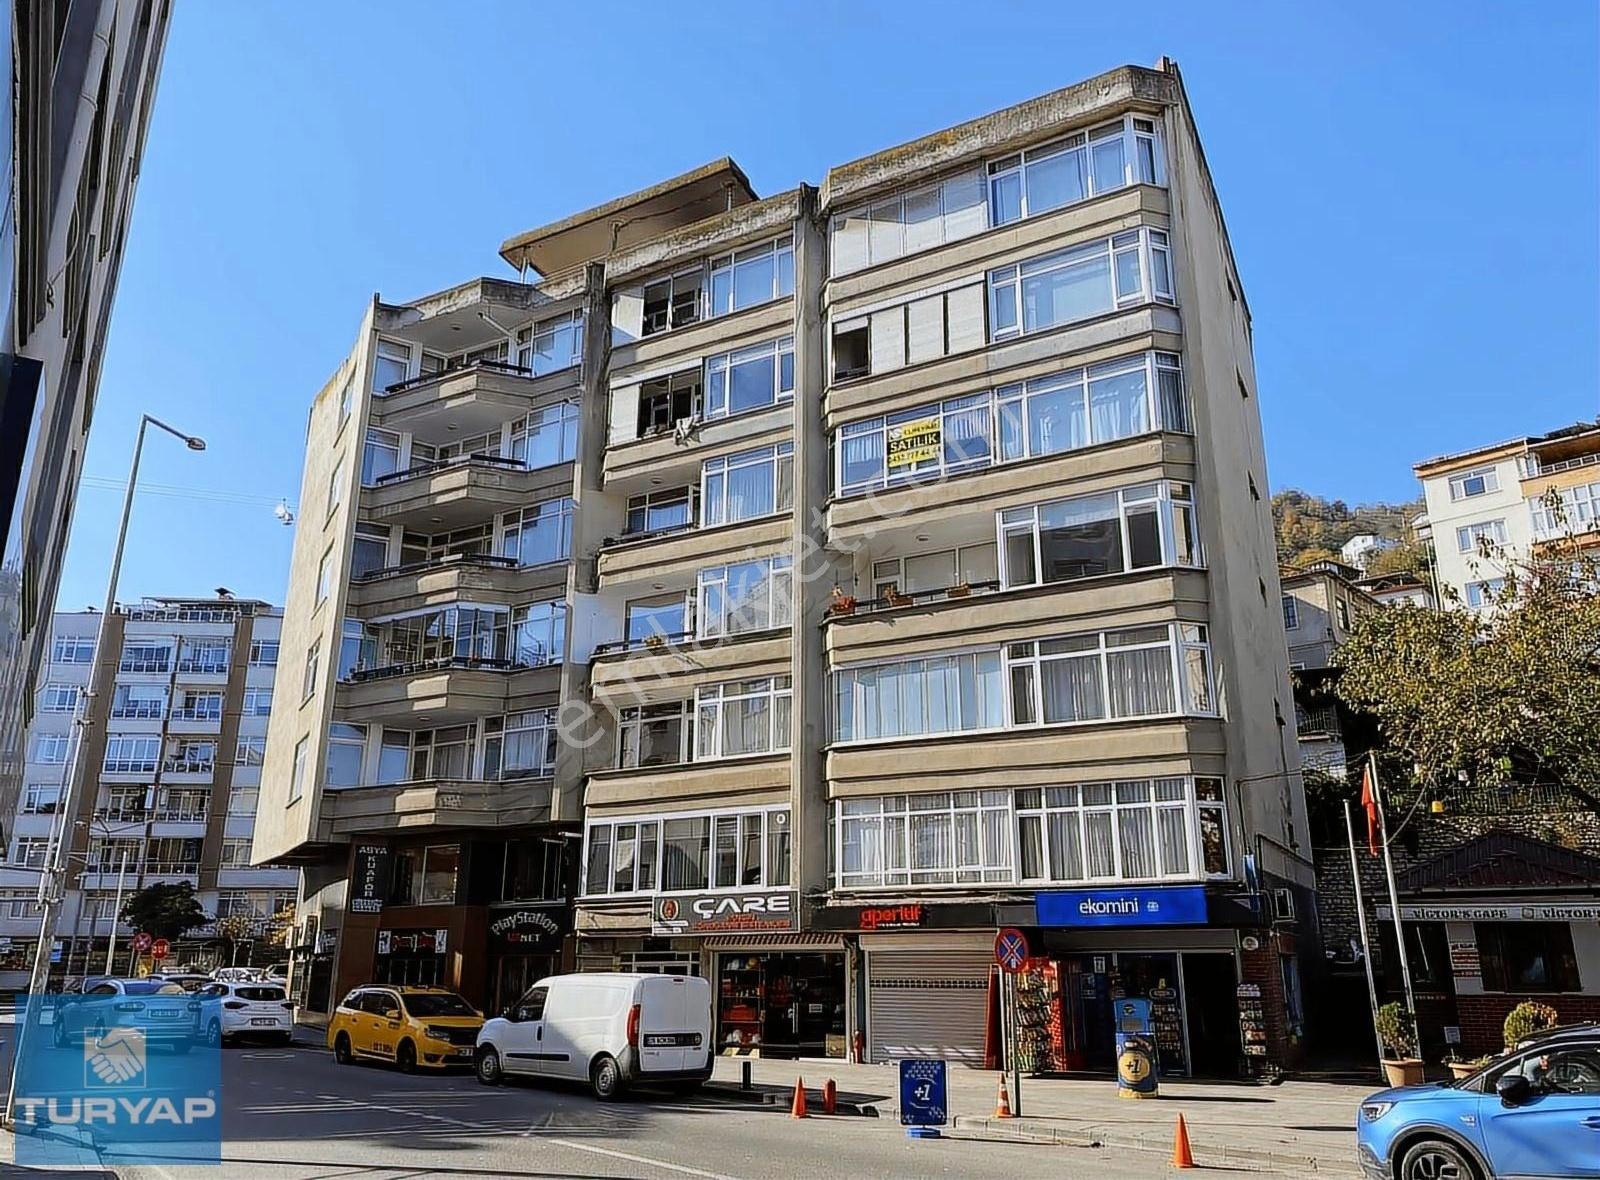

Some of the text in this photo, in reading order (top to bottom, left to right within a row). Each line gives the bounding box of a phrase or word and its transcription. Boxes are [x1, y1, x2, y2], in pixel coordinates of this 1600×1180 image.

[890, 433, 937, 453] SATILIK
[692, 895, 790, 920] ÇARE
[1079, 897, 1139, 914] ekomini
[1473, 908, 1508, 919] CAFE
[913, 1084, 931, 1101] +1
